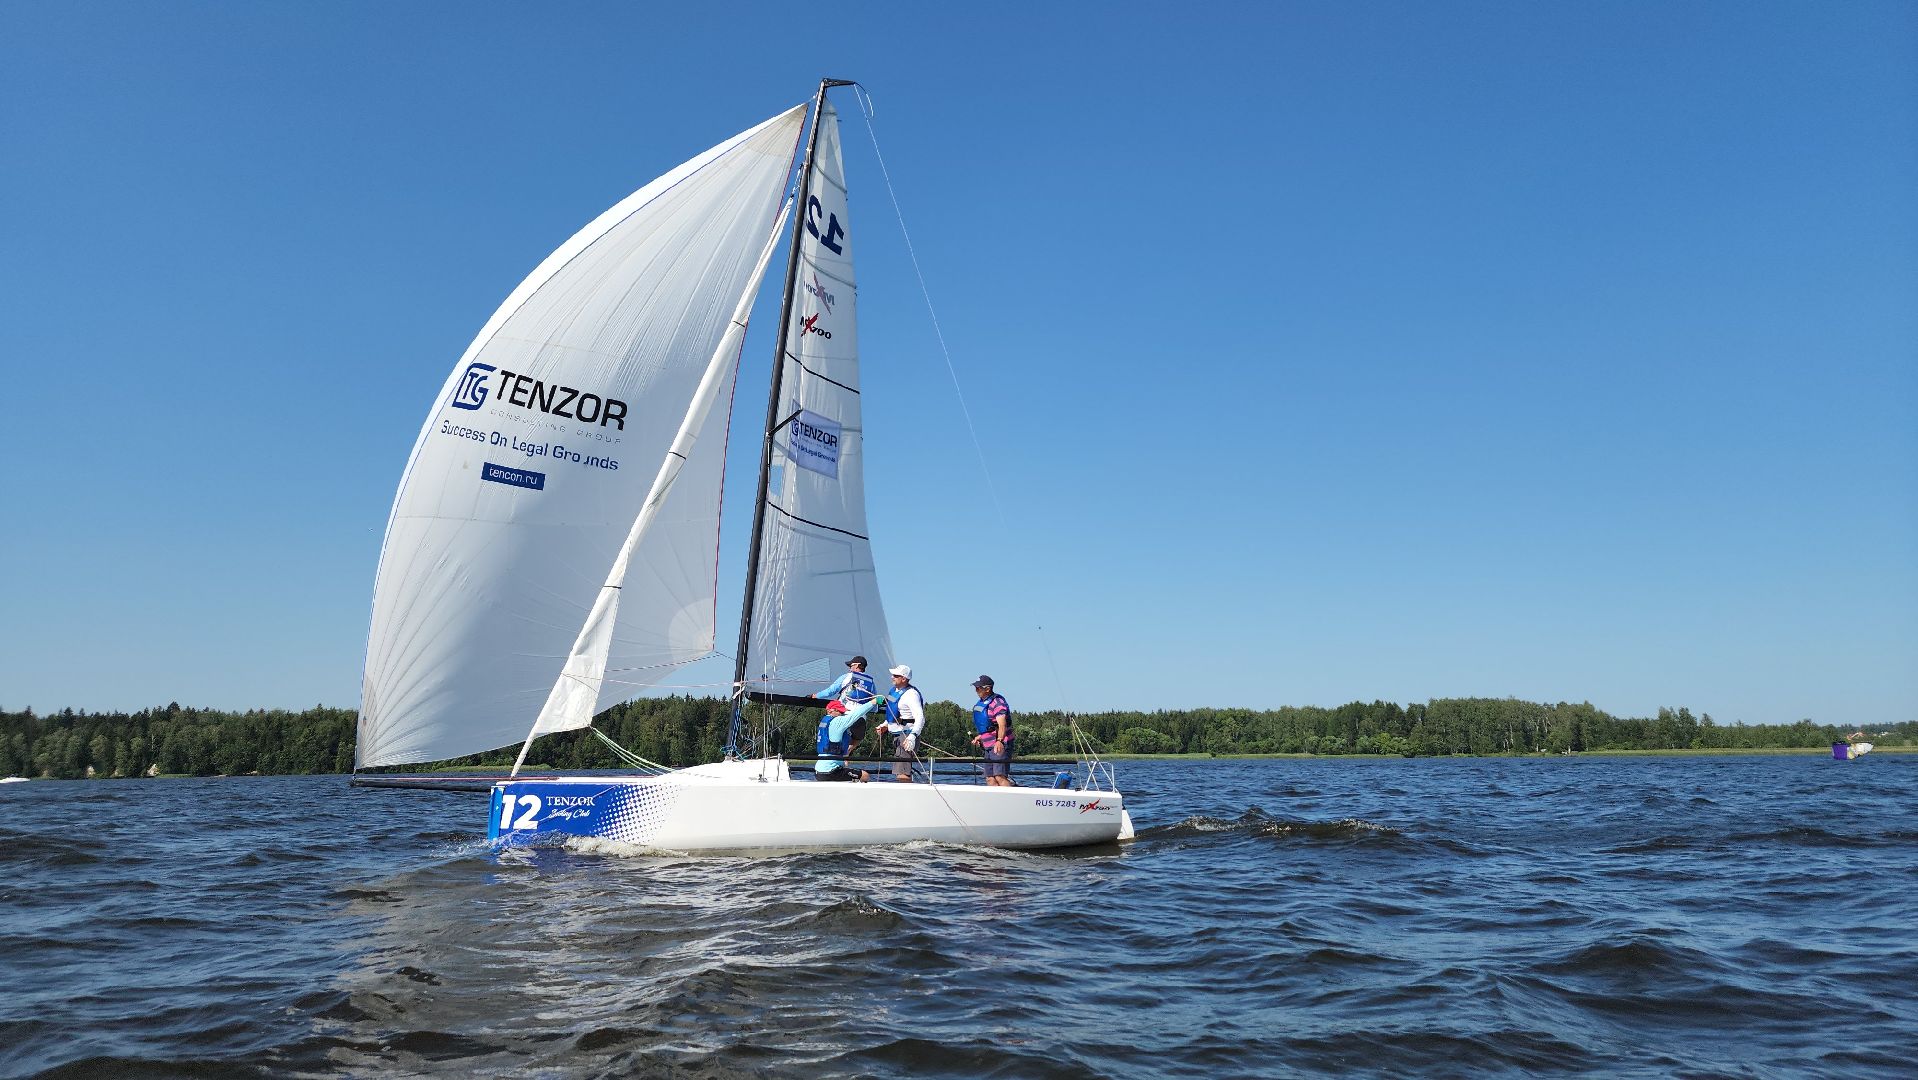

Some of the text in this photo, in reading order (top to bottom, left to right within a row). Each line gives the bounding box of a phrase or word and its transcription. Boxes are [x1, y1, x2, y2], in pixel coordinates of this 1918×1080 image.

[496, 369, 628, 431] TENZOR
[441, 419, 486, 443] Success
[490, 431, 507, 447] On
[512, 435, 549, 457] Legal
[799, 421, 838, 448] TENZOR
[489, 466, 538, 485] tencon.ru
[500, 794, 542, 830] 12
[545, 796, 596, 806] TENZOR
[1035, 799, 1053, 807] RUS
[572, 808, 591, 819] Club
